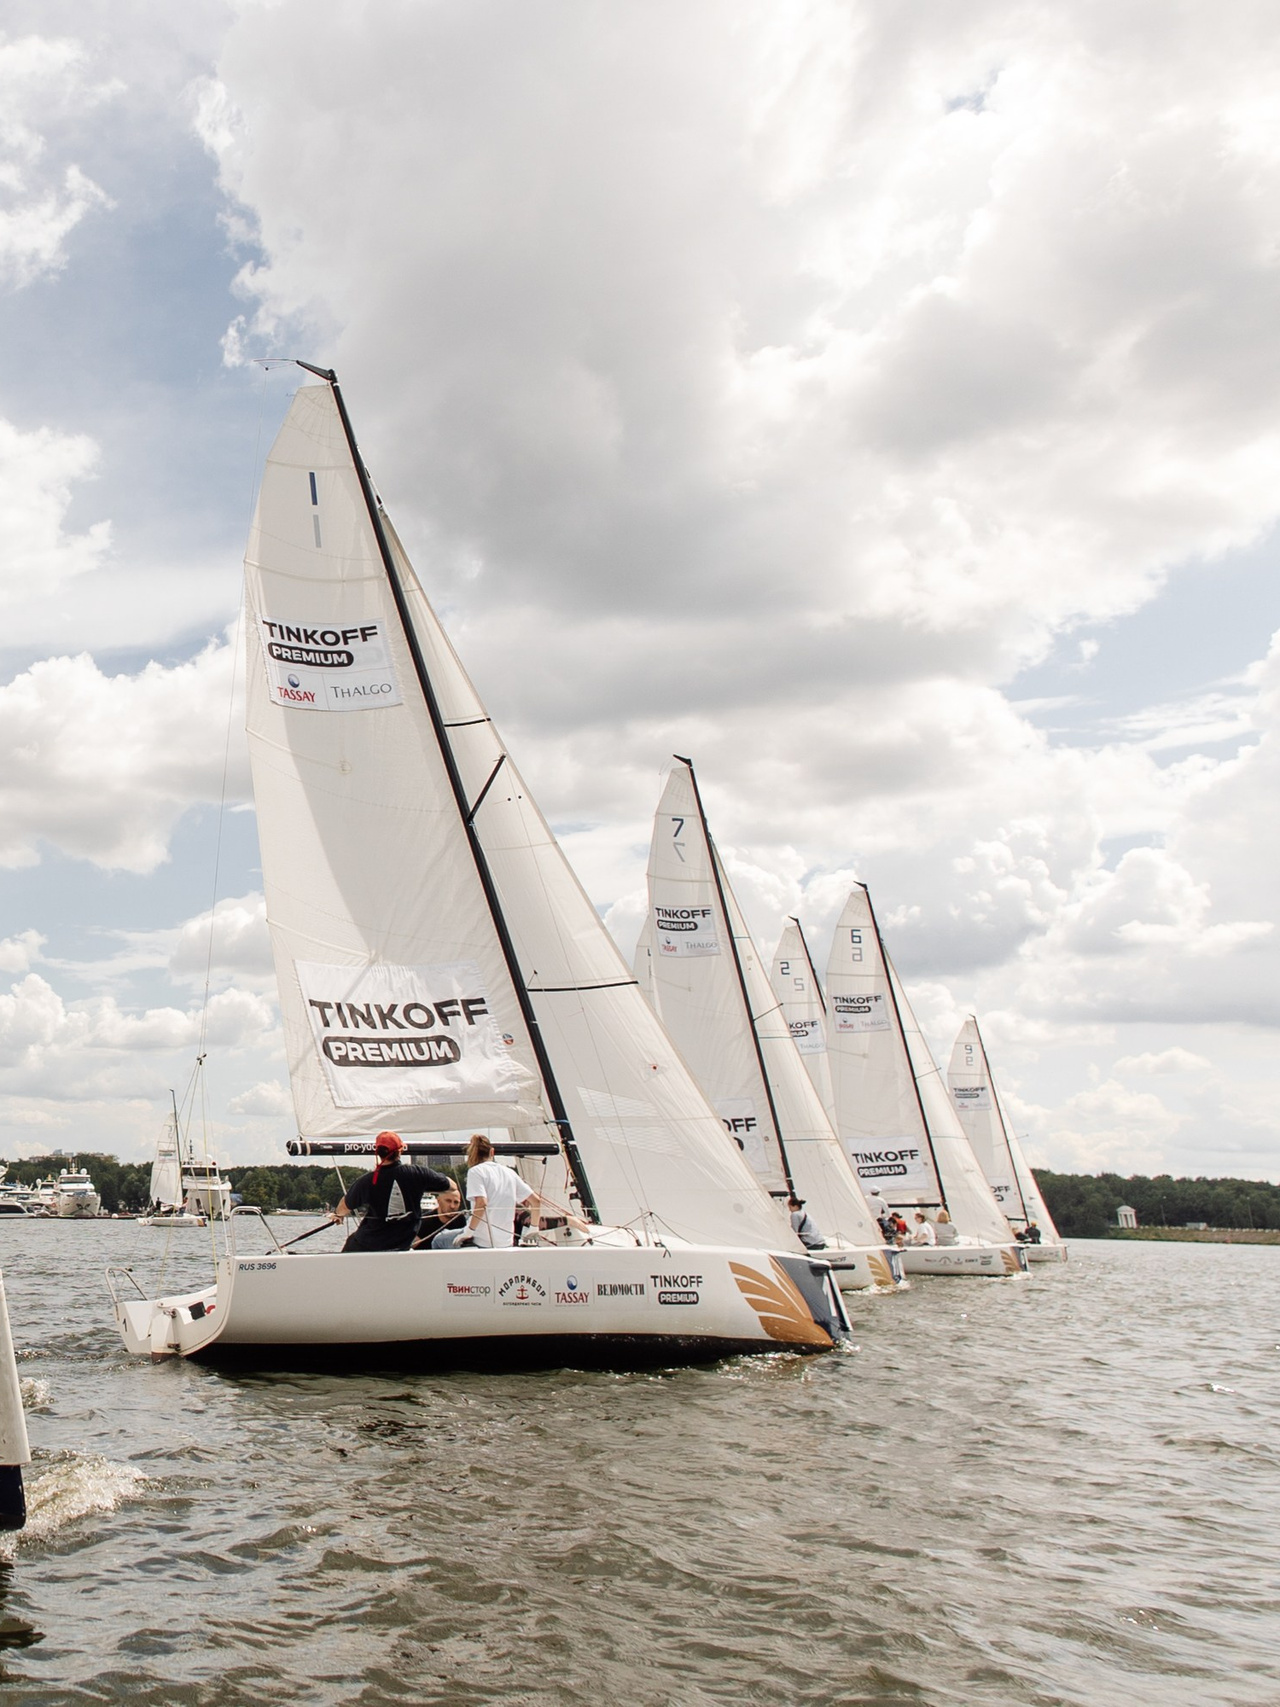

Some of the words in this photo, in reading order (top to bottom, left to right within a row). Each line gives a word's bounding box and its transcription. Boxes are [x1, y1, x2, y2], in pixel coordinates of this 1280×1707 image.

[262, 620, 378, 646] TINKOFF
[271, 645, 349, 666] PREMIUM
[276, 686, 316, 703] TASSAY
[330, 683, 393, 699] THALGO
[671, 817, 685, 837] 7
[655, 907, 711, 919] TINKOFF
[850, 928, 862, 944] 6
[780, 961, 790, 975] 2
[833, 995, 882, 1005] TINKOFF
[308, 997, 489, 1029] TINKOFF
[327, 1040, 454, 1062] PREMIUM
[852, 1149, 919, 1164] TINKOFF
[858, 1165, 905, 1176] PREMIUM
[239, 1263, 255, 1271] RUS
[650, 1275, 703, 1288] TINKOFF
[555, 1292, 590, 1304] TASSAY
[659, 1293, 697, 1303] PREMIUM
